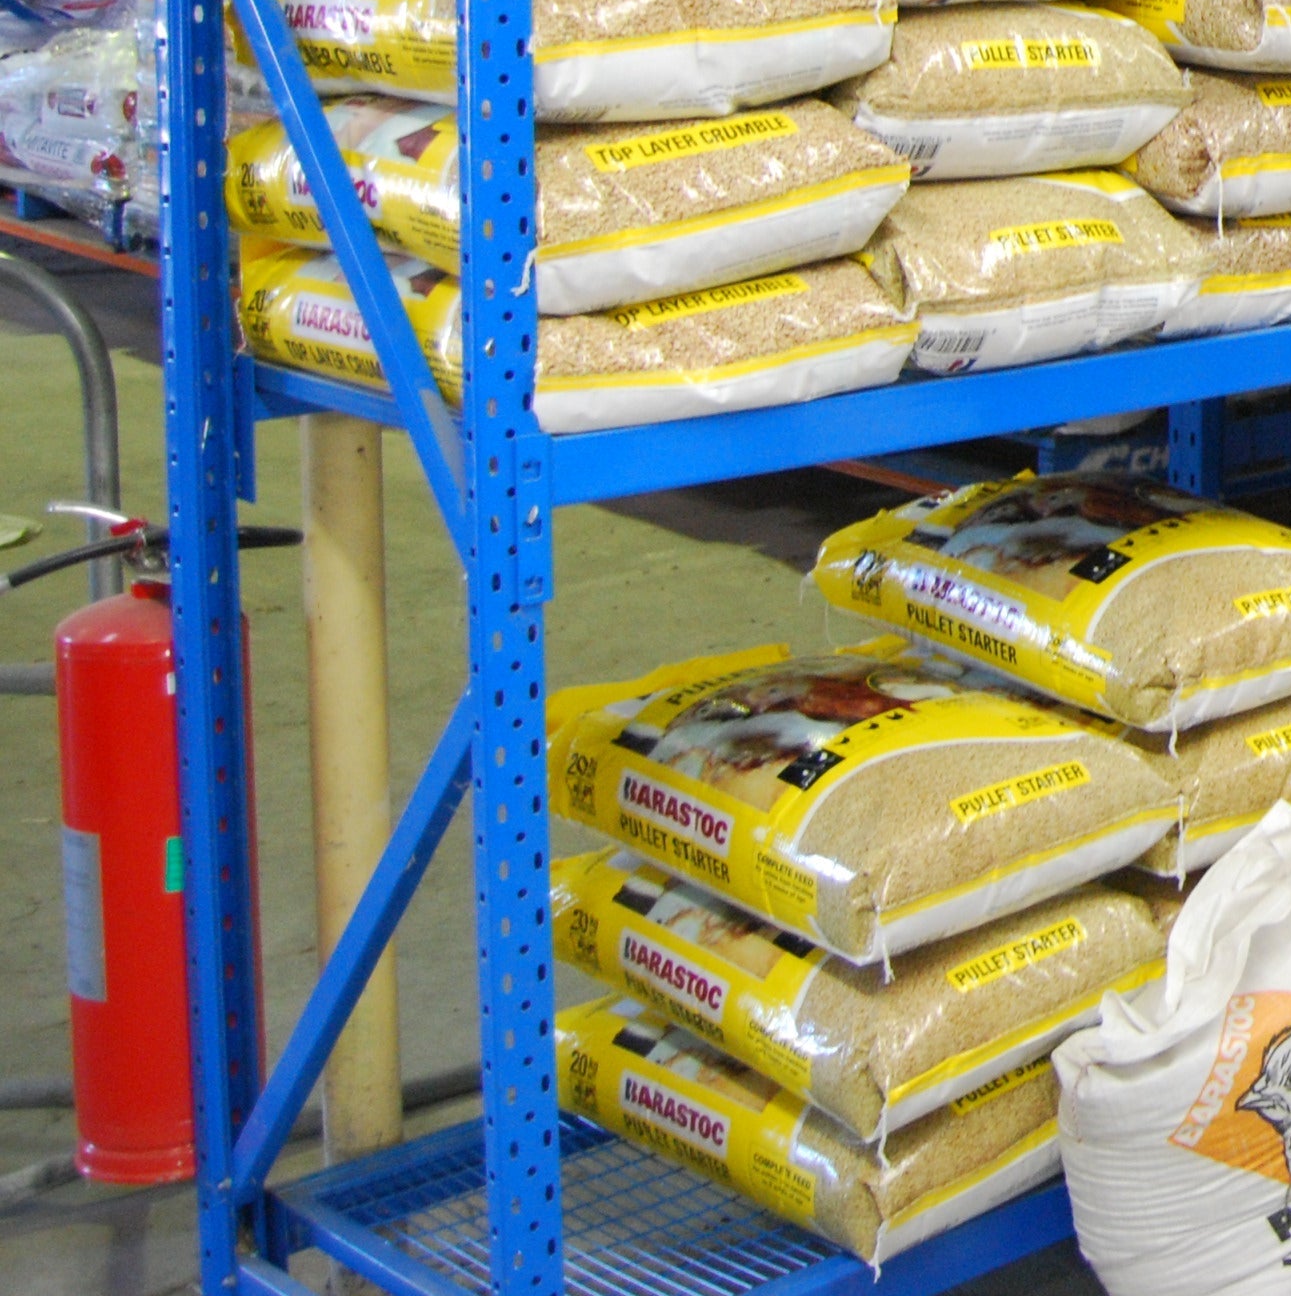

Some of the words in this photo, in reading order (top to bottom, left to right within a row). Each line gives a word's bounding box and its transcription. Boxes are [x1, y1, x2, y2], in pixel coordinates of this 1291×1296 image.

[1026, 44, 1095, 63] STARTER
[595, 147, 633, 167] TOP
[637, 133, 698, 158] LAYER
[699, 116, 789, 146] CRUMBLE
[1056, 220, 1119, 240] STARTER
[614, 307, 644, 329] OP
[650, 292, 708, 317] LAYER
[709, 277, 801, 304] CRUMBLE
[906, 602, 956, 637] PULLET
[957, 622, 1019, 666] STARTER
[623, 775, 728, 847] BARASTOC
[957, 786, 1014, 818] PULLET
[1016, 763, 1085, 796] STARTER
[619, 814, 667, 851] PULLET
[671, 837, 731, 884] STARTER
[623, 935, 723, 1011] BARASTOC
[953, 952, 1010, 988] PULLET
[1011, 921, 1083, 960] STARTER
[954, 1074, 1011, 1109] PULLET
[1174, 994, 1257, 1149] BARASTOC
[623, 1077, 725, 1147] BARASTOC
